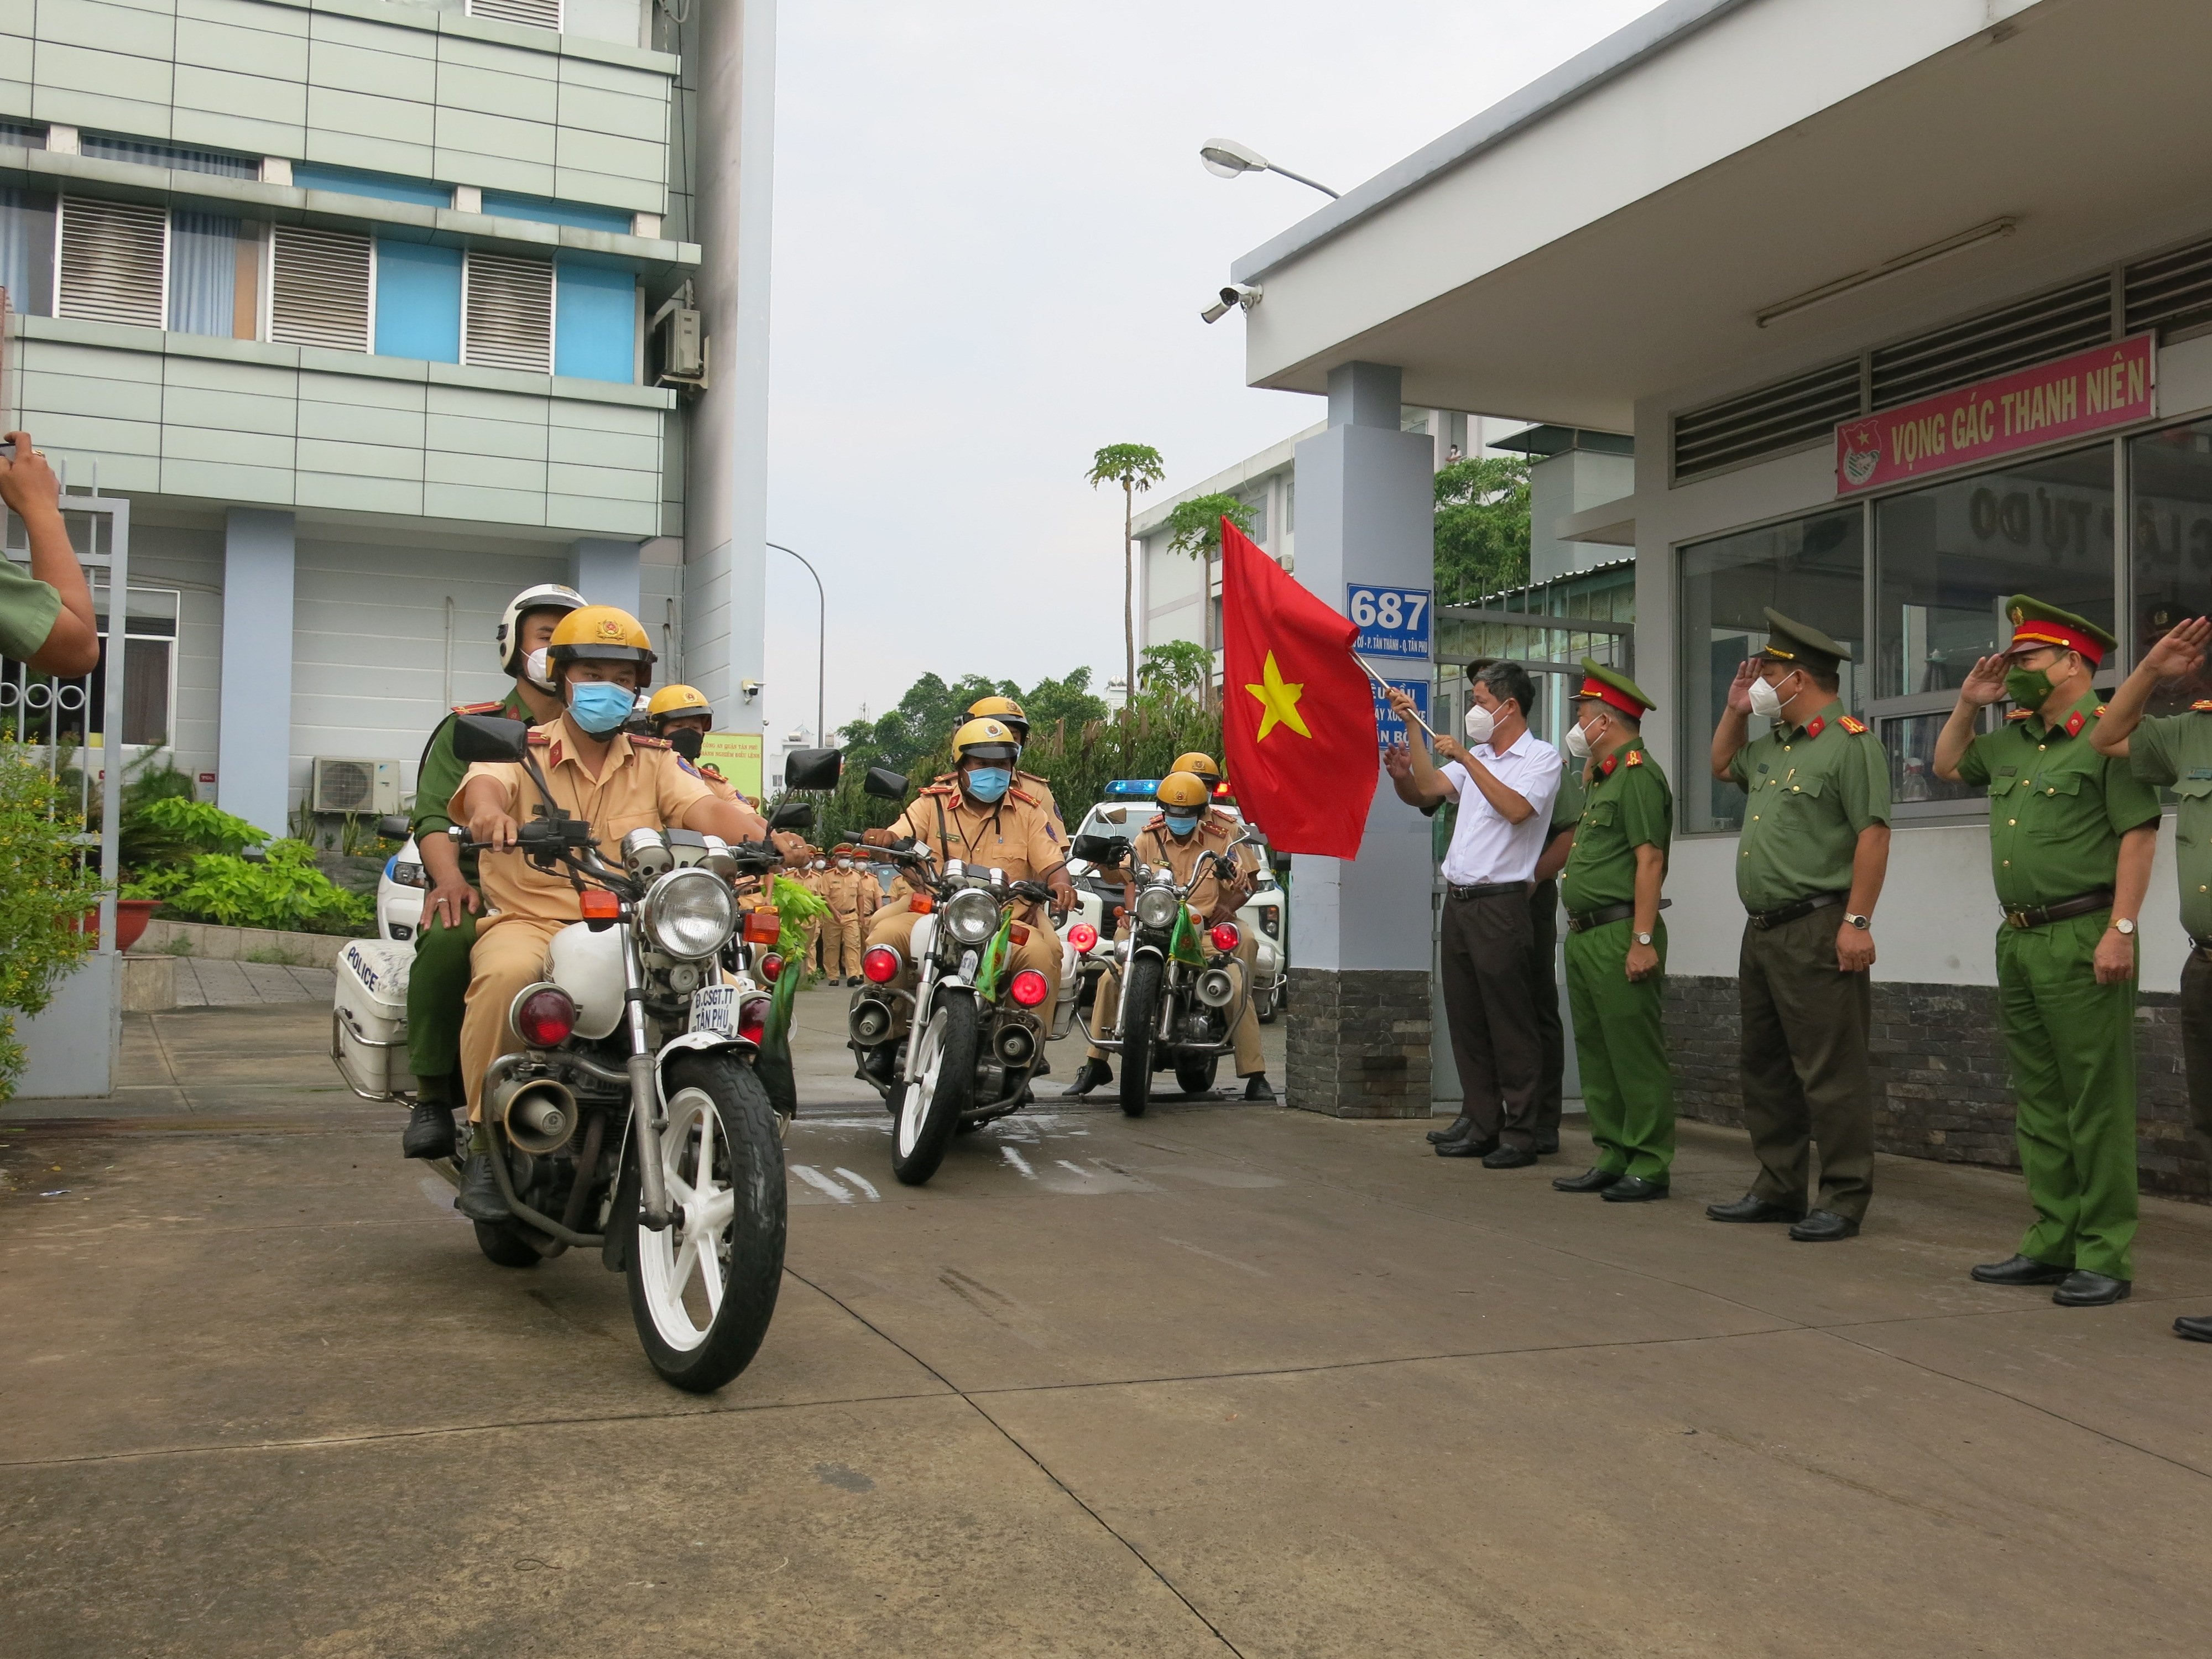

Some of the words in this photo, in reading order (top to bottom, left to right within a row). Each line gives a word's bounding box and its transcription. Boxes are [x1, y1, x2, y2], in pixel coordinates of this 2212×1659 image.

[1891, 413, 1945, 471] VỌNG
[1952, 392, 1994, 450] GÁC
[2001, 375, 2077, 437] THANH
[2086, 351, 2144, 416] NIÊN
[1351, 590, 1427, 631] 687
[1367, 637, 1373, 649] P.
[1373, 634, 1383, 649] TÂN
[1383, 635, 1399, 651] THÀNH
[1402, 639, 1407, 653] Q.
[1408, 637, 1417, 652] TÂN
[1418, 638, 1428, 653] PHÚ
[347, 946, 379, 992] POLICE
[696, 988, 734, 1009] Đ.CSGT.TT
[696, 1007, 711, 1031] TÂN
[712, 1004, 729, 1029] PHÚ
